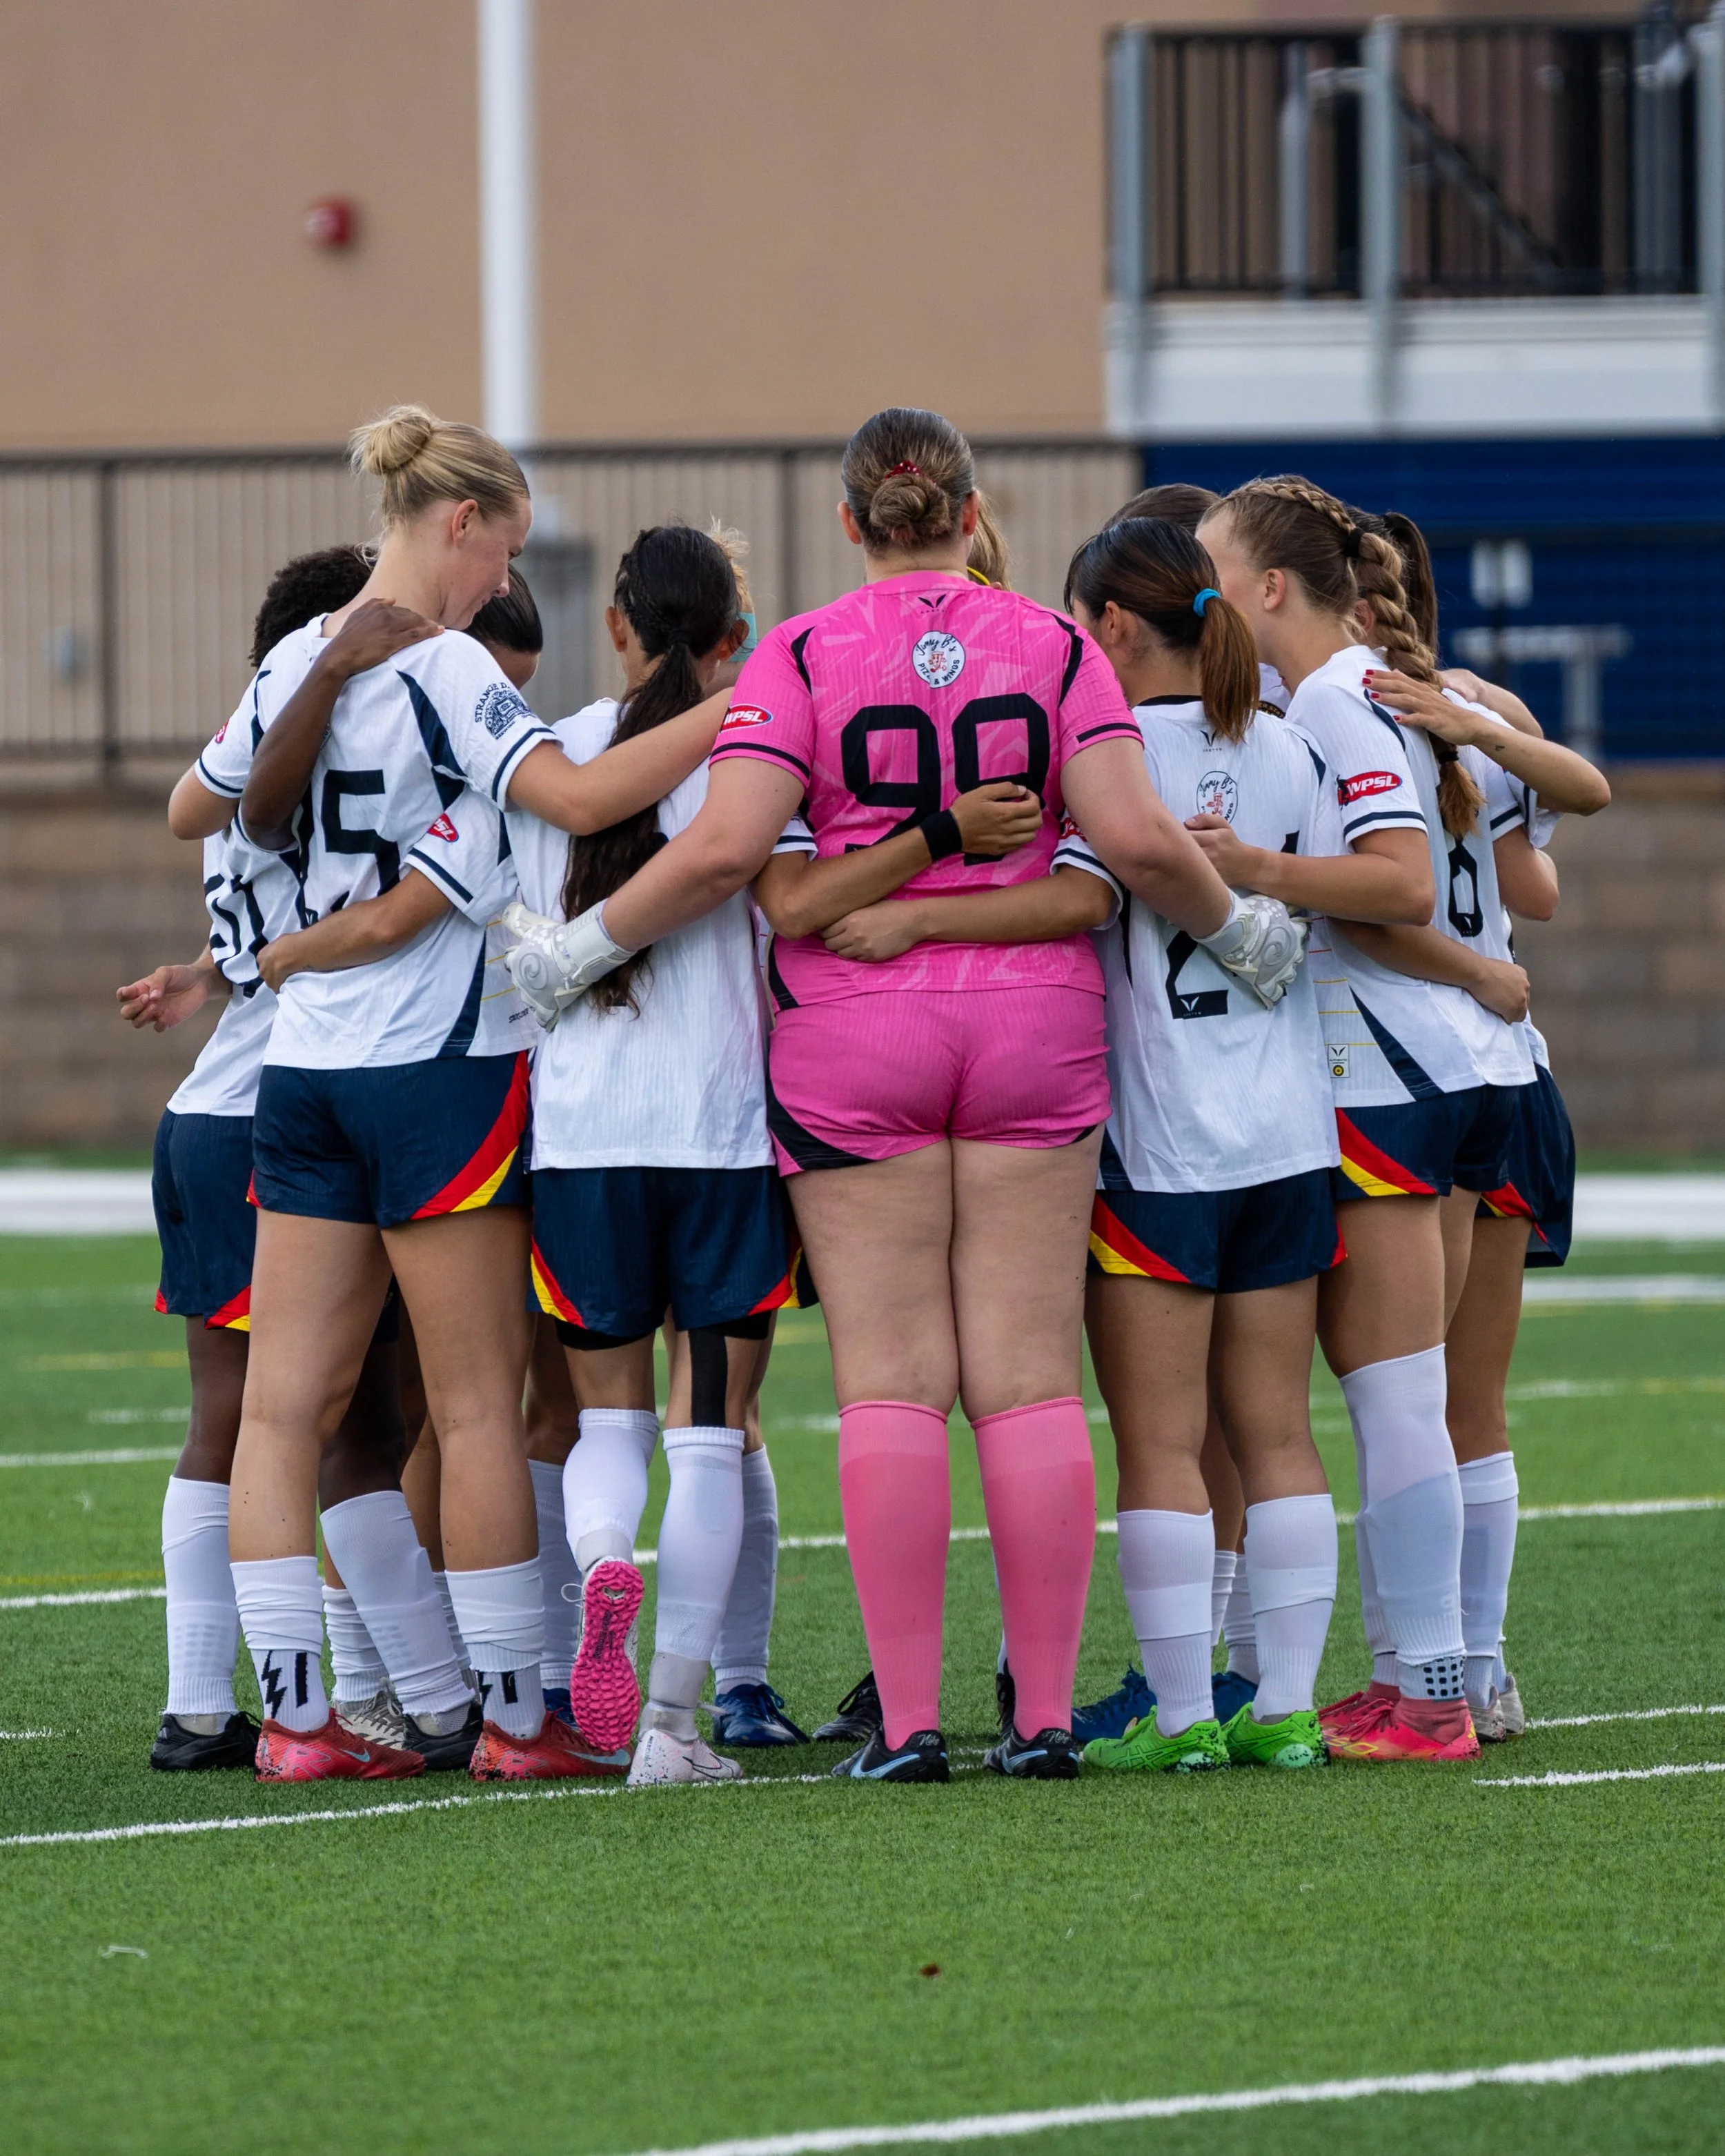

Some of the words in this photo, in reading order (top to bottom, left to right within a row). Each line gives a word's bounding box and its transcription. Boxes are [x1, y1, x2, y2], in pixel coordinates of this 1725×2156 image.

[941, 659, 960, 682] WINGS
[474, 682, 500, 723] STRANGE
[1347, 775, 1397, 796] WPSL
